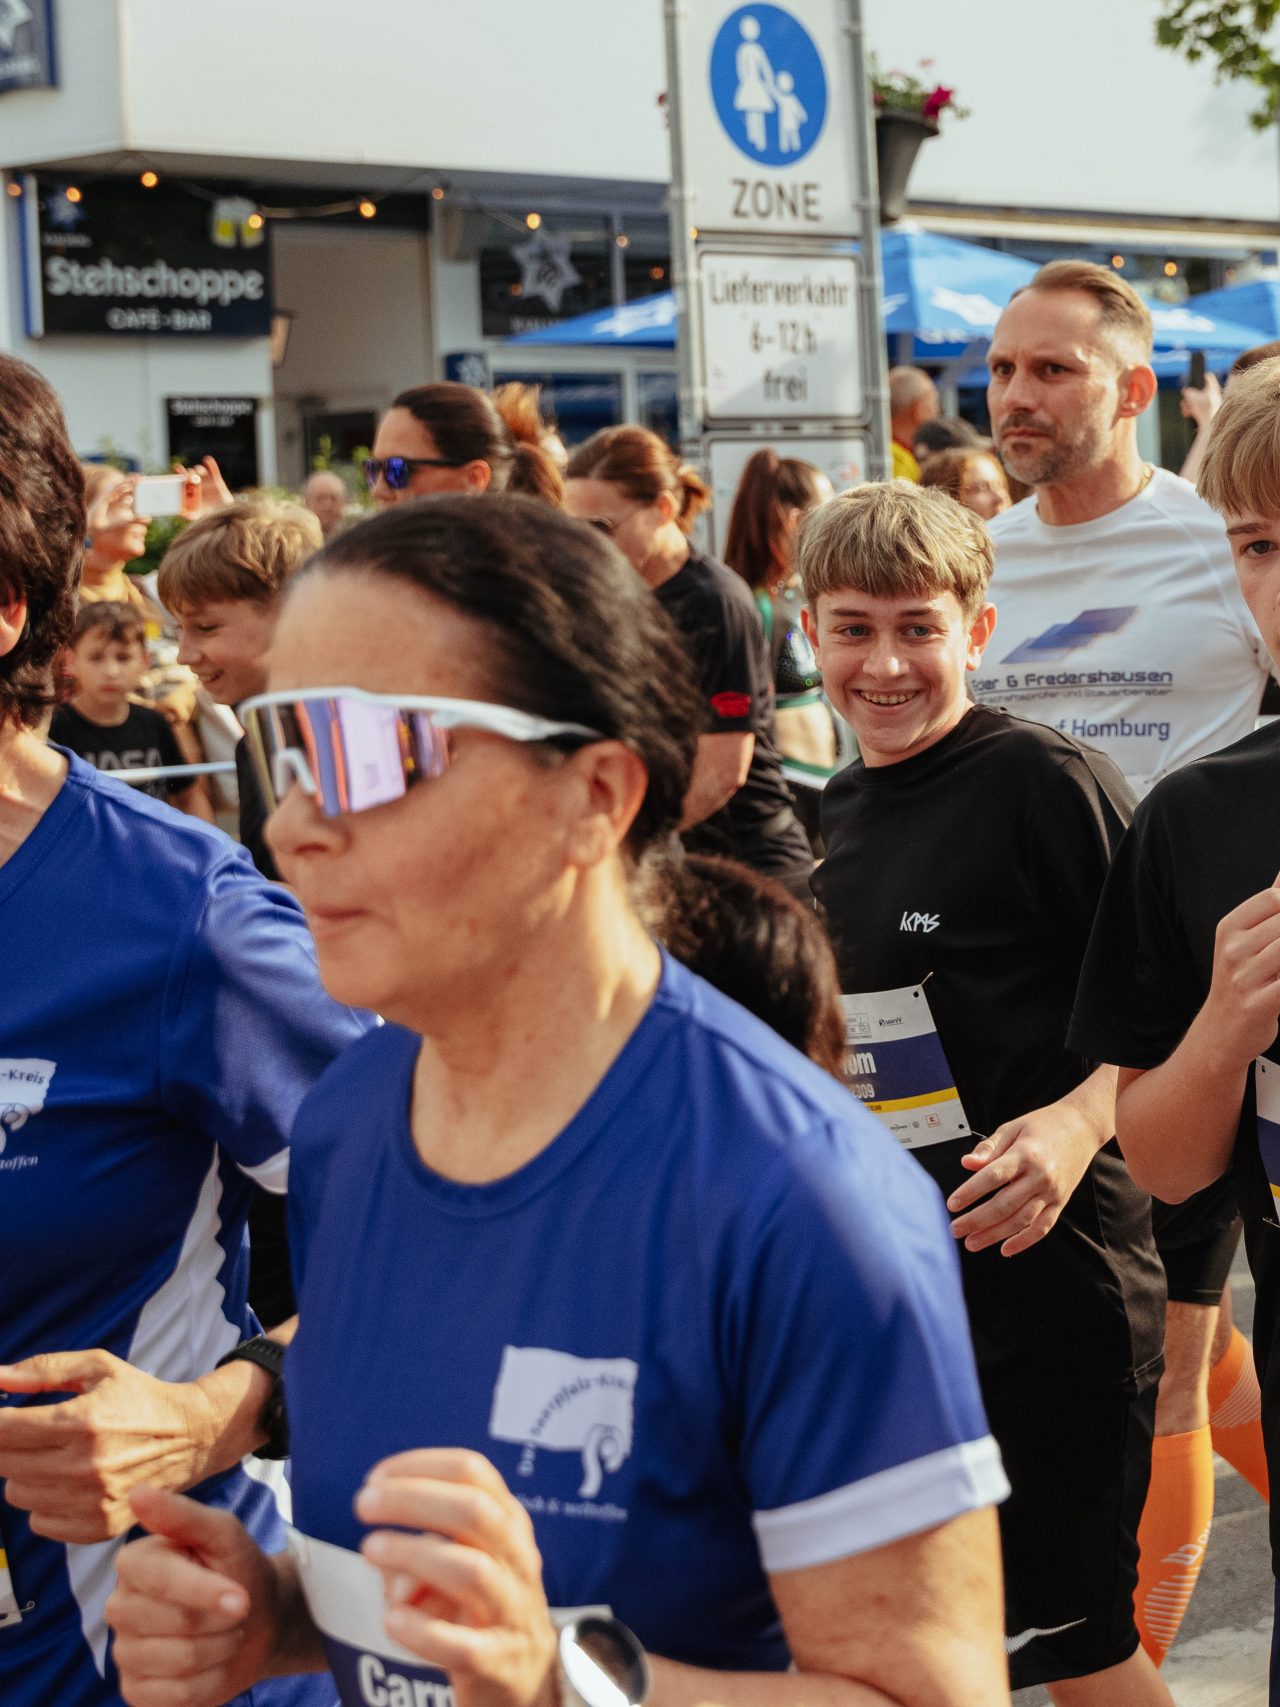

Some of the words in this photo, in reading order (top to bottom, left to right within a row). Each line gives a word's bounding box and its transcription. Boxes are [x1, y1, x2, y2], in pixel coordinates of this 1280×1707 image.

[731, 179, 821, 222] ZONE
[47, 257, 264, 306] Stehschoppe
[709, 270, 849, 309] Lieferverkehr
[764, 370, 808, 402] frei
[1025, 670, 1173, 686] Fredershausen
[1072, 718, 1170, 741] Homburg
[844, 1052, 877, 1075] om
